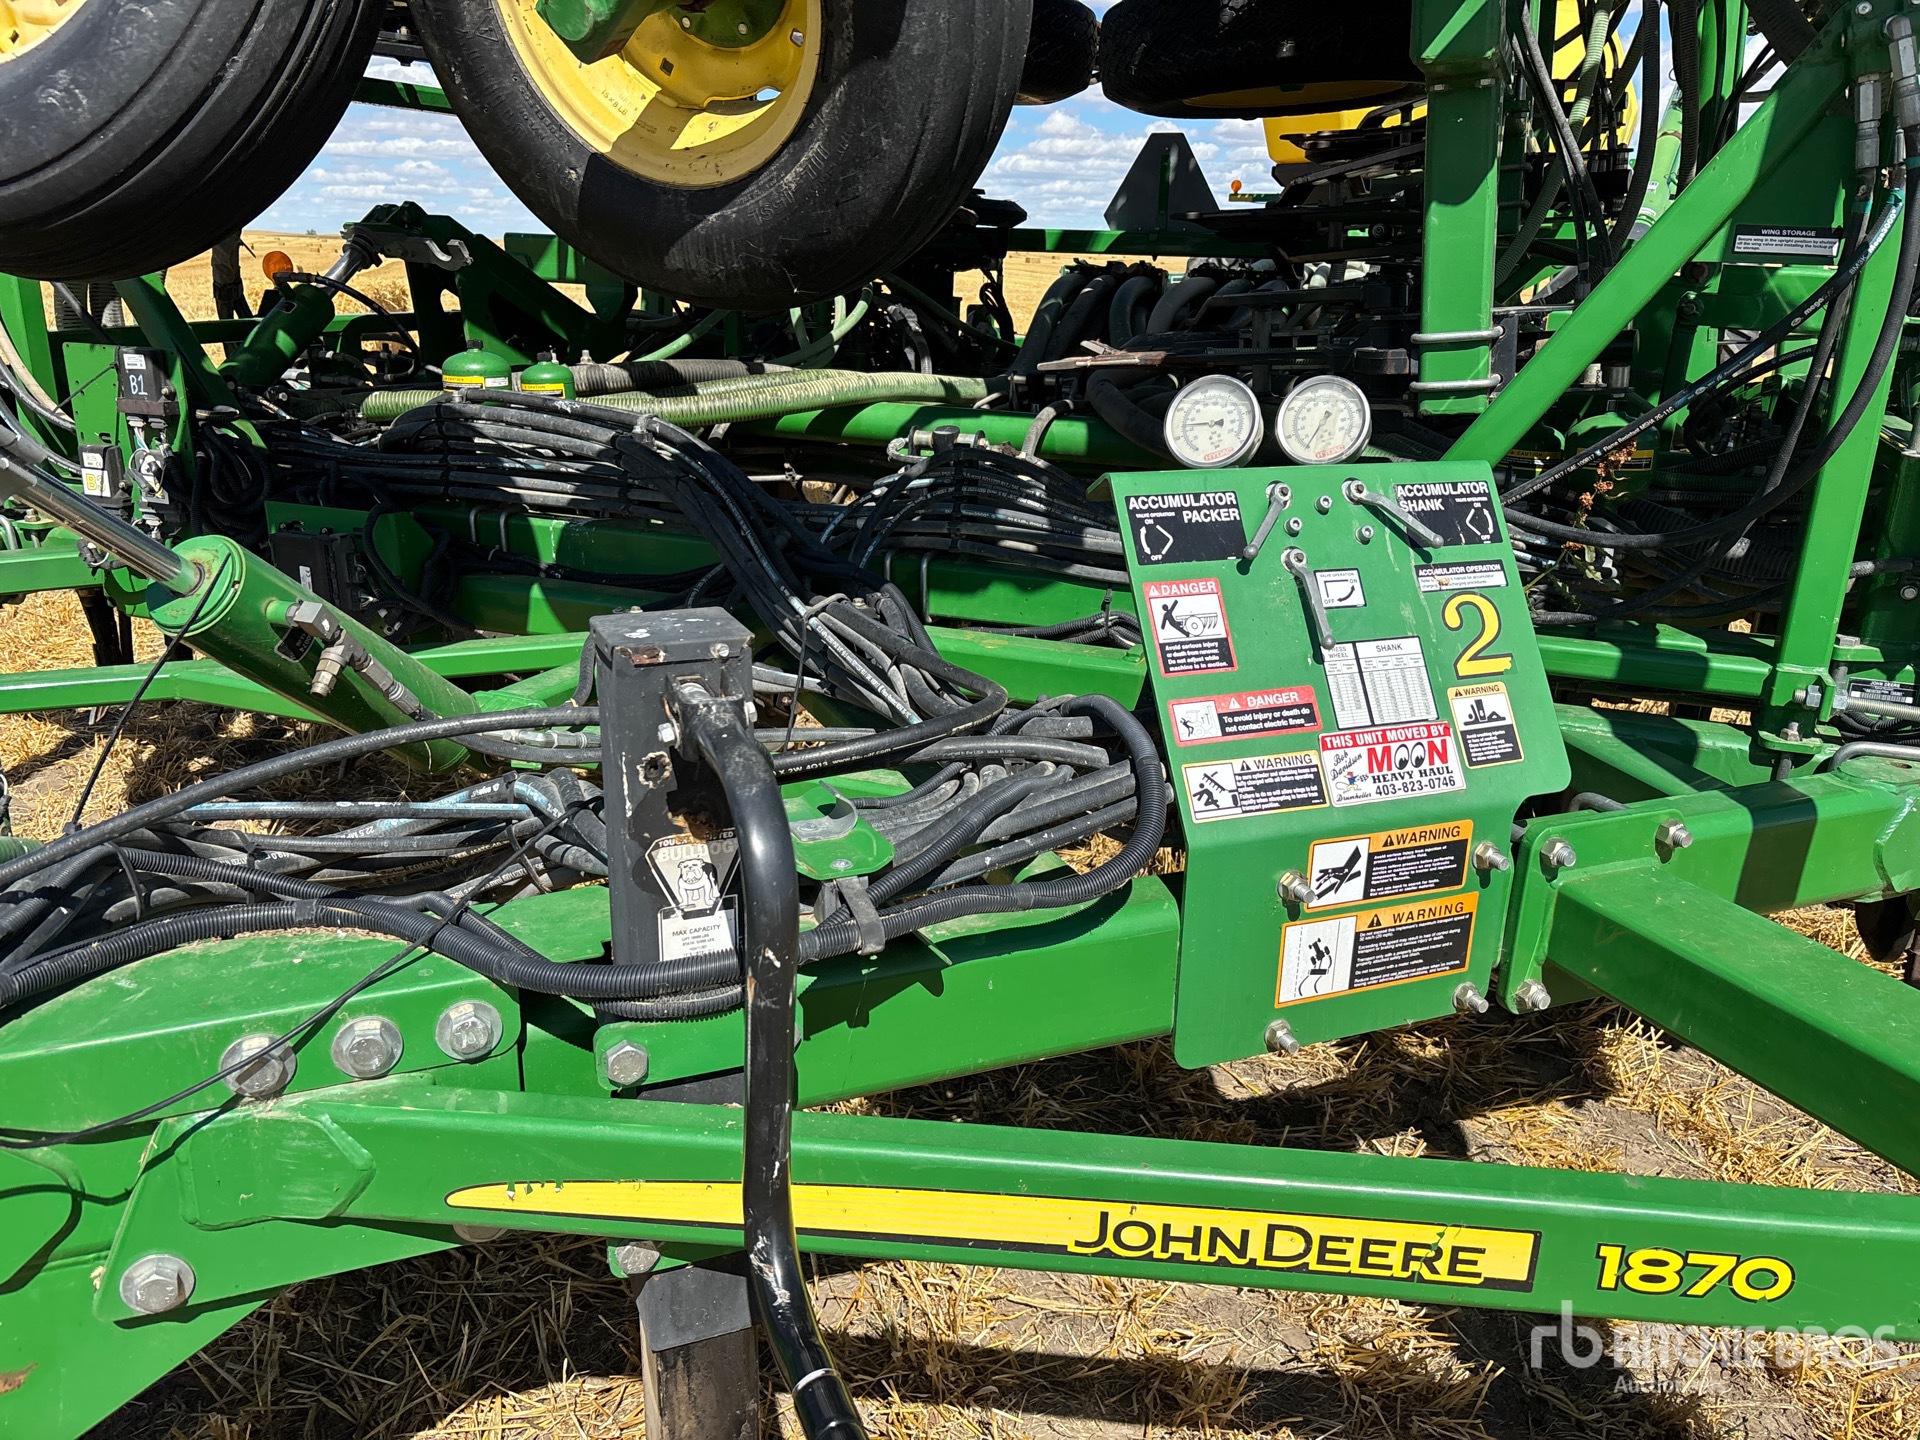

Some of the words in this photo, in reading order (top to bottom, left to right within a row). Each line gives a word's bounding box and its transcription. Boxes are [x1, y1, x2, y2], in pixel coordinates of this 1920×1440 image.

[129, 374, 148, 396] B1
[1204, 447, 1234, 461] HYDAC
[1397, 482, 1489, 498] ACCUMULATOR
[1129, 492, 1237, 510] ACCUMULATOR
[1399, 498, 1445, 512] SHANK
[1182, 508, 1240, 523] PACKER
[1419, 567, 1465, 576] ACCUMULATOR
[1466, 564, 1501, 572] OPERATION
[1161, 581, 1217, 595] DANGER
[1441, 591, 1514, 680] 2
[1376, 643, 1403, 652] SHANK
[1463, 685, 1500, 695] WARNING
[1246, 692, 1299, 707] DANGER
[1233, 713, 1252, 721] avoid
[1253, 712, 1272, 721] injury
[1282, 708, 1300, 716] death
[1238, 722, 1263, 731] contact
[1264, 719, 1288, 728] electric
[1324, 735, 1353, 749] THIS
[1355, 732, 1385, 745] UNIT
[1386, 727, 1428, 742] MOVED
[1430, 724, 1446, 736] BY
[1254, 754, 1313, 770] WARNING
[1372, 771, 1414, 784] HEAVY
[1419, 766, 1453, 778] HAUL
[1375, 775, 1455, 796] 403-823-0746
[659, 839, 687, 847] TOU
[1396, 826, 1460, 845] WARNING
[657, 841, 734, 861] BULLDOG
[1392, 902, 1464, 924] WARNING
[689, 924, 721, 934] CAPACITY
[1073, 1211, 1248, 1263] JOHN
[1266, 1224, 1486, 1281] DEERE
[1597, 1243, 1795, 1302] 1870
